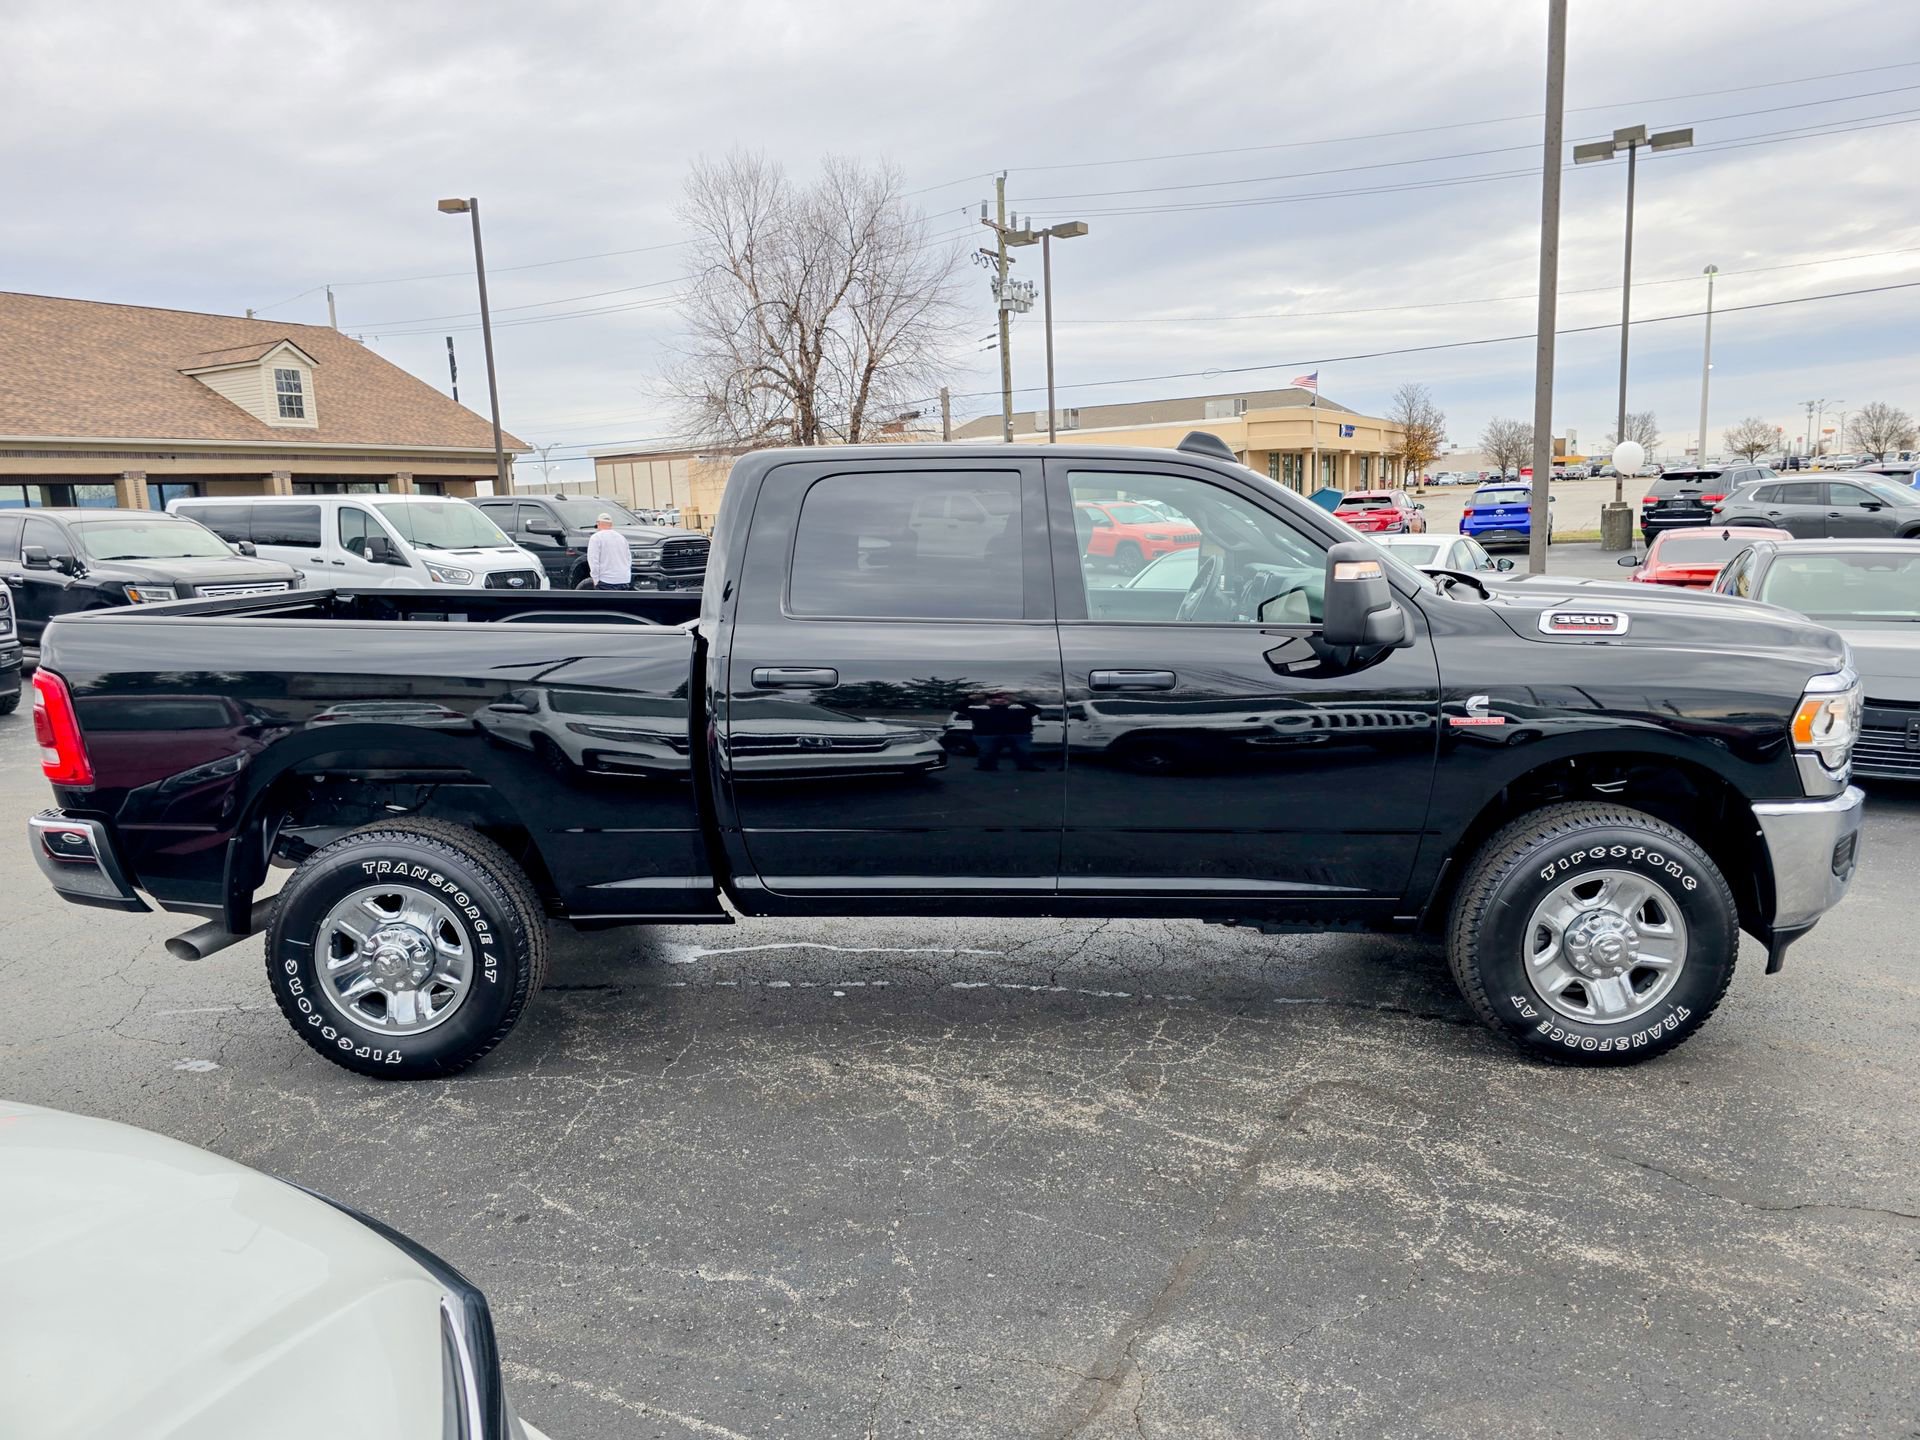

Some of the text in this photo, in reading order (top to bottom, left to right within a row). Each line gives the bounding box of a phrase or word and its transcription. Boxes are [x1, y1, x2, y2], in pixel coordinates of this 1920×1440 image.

[1555, 615, 1614, 625] 3500
[1540, 845, 1697, 890] Firestone
[362, 861, 497, 983] TRANSFORCE AT
[284, 958, 402, 1064] Firestone
[1511, 995, 1691, 1051] TRANSFORCE AT
